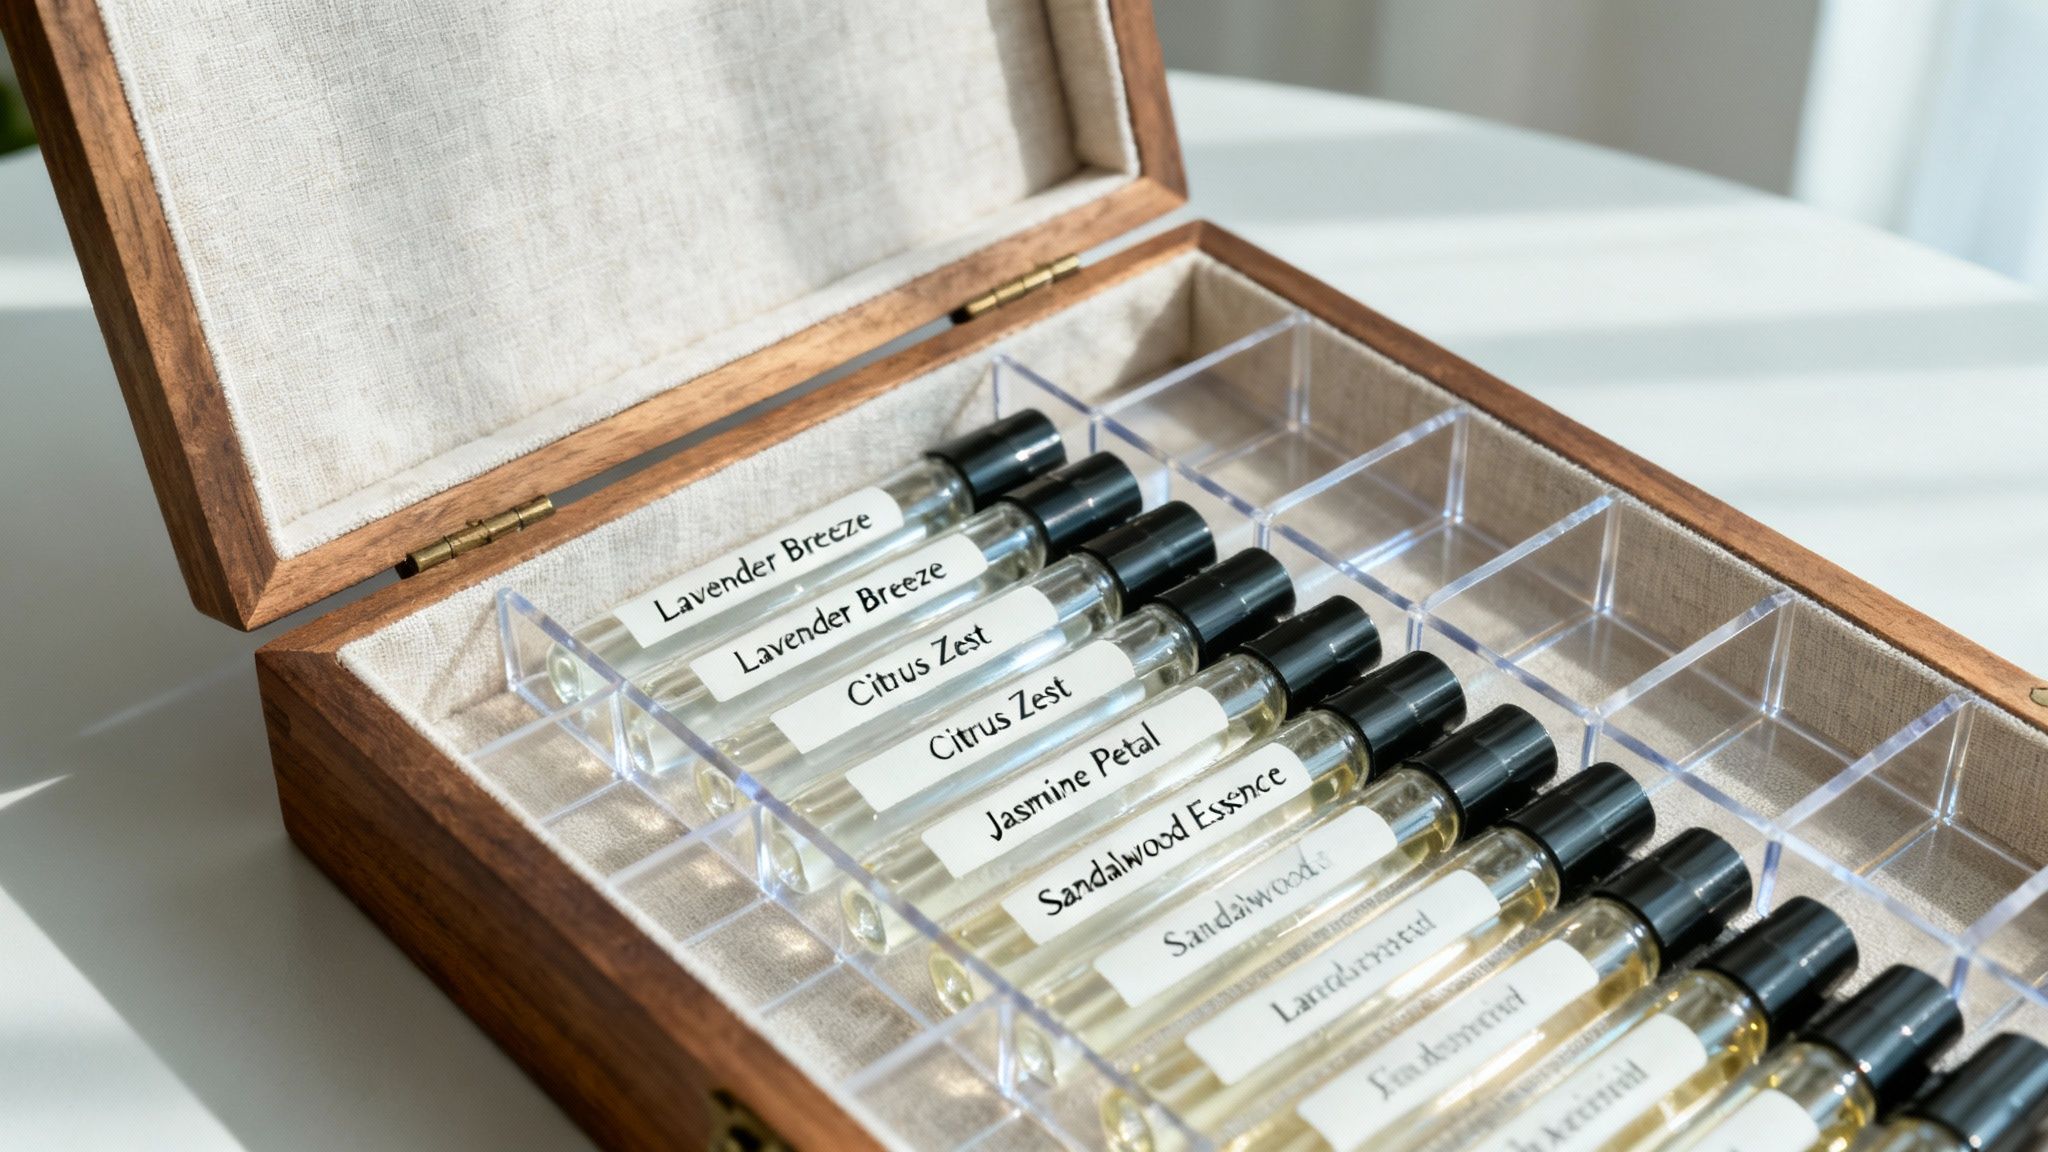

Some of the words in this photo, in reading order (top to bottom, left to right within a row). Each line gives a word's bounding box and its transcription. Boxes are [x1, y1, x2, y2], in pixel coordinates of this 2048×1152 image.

[653, 551, 777, 622] Lavender
[781, 510, 874, 562] Breeze
[734, 605, 852, 674] Lavender
[856, 559, 948, 613] Breeze
[847, 655, 931, 706] Citrus
[931, 624, 992, 665] Zest
[929, 709, 1011, 761] Citrus
[1008, 675, 1072, 720] Zest
[986, 769, 1090, 841] Jasmine
[1090, 721, 1161, 778] Petal
[1038, 813, 1190, 917] Sandalwood
